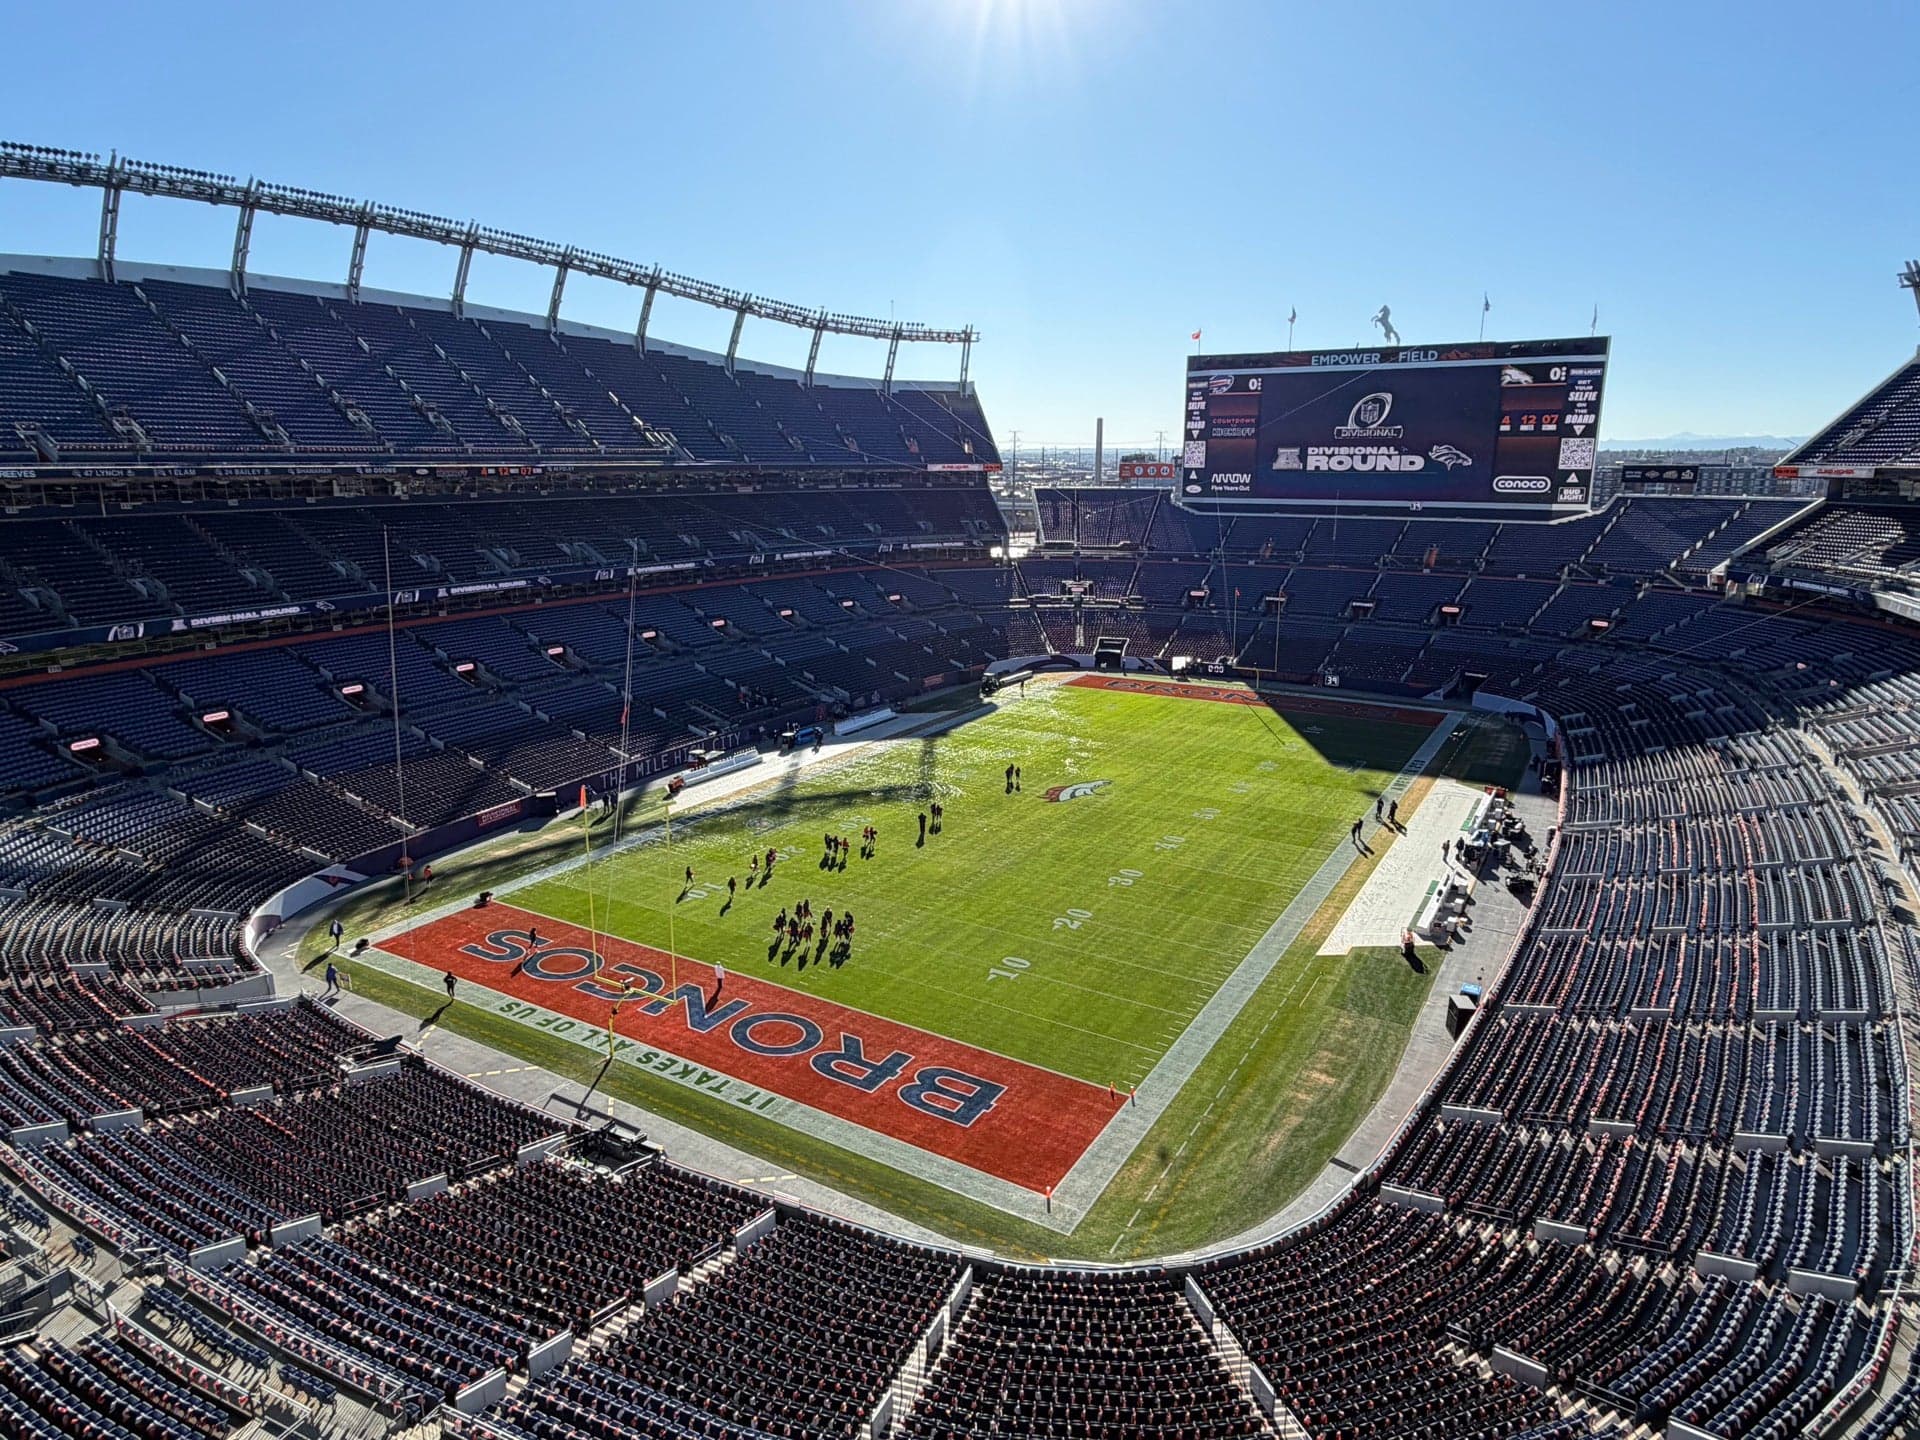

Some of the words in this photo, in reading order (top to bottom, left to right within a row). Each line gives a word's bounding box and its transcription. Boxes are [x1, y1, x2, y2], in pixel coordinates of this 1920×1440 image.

[1311, 353, 1381, 366] EMPOWER
[1398, 350, 1438, 362] FIELD
[1568, 392, 1598, 401] SELFIE
[1501, 415, 1511, 424] 4
[1521, 415, 1536, 424] 12
[1542, 415, 1559, 424] 07
[1565, 414, 1595, 424] BOARD
[1341, 429, 1397, 437] DIVISIONAL
[1308, 446, 1399, 455] DIVISIONAL
[1307, 455, 1424, 471] ROUND
[1211, 473, 1252, 484] ARROW
[450, 583, 498, 594] DIVISIONAL
[498, 580, 527, 589] ROUND
[190, 611, 260, 626] DIVISIONAL
[260, 606, 301, 618] ROUND
[1327, 676, 1338, 685] 39
[600, 769, 627, 789] THE
[635, 756, 670, 779] MILE
[712, 732, 741, 752] CITY
[481, 804, 518, 823] DIVISIONAL
[1158, 834, 1186, 852] 40
[1115, 868, 1145, 887] 30
[1058, 907, 1093, 930] 20
[992, 956, 1031, 982] 10
[498, 1001, 537, 1020] US
[458, 928, 1009, 1128] BRONCOS
[535, 1017, 577, 1033] OF
[580, 1028, 633, 1054] ALL
[635, 1050, 732, 1095] TAKES
[735, 1090, 777, 1111] IT
